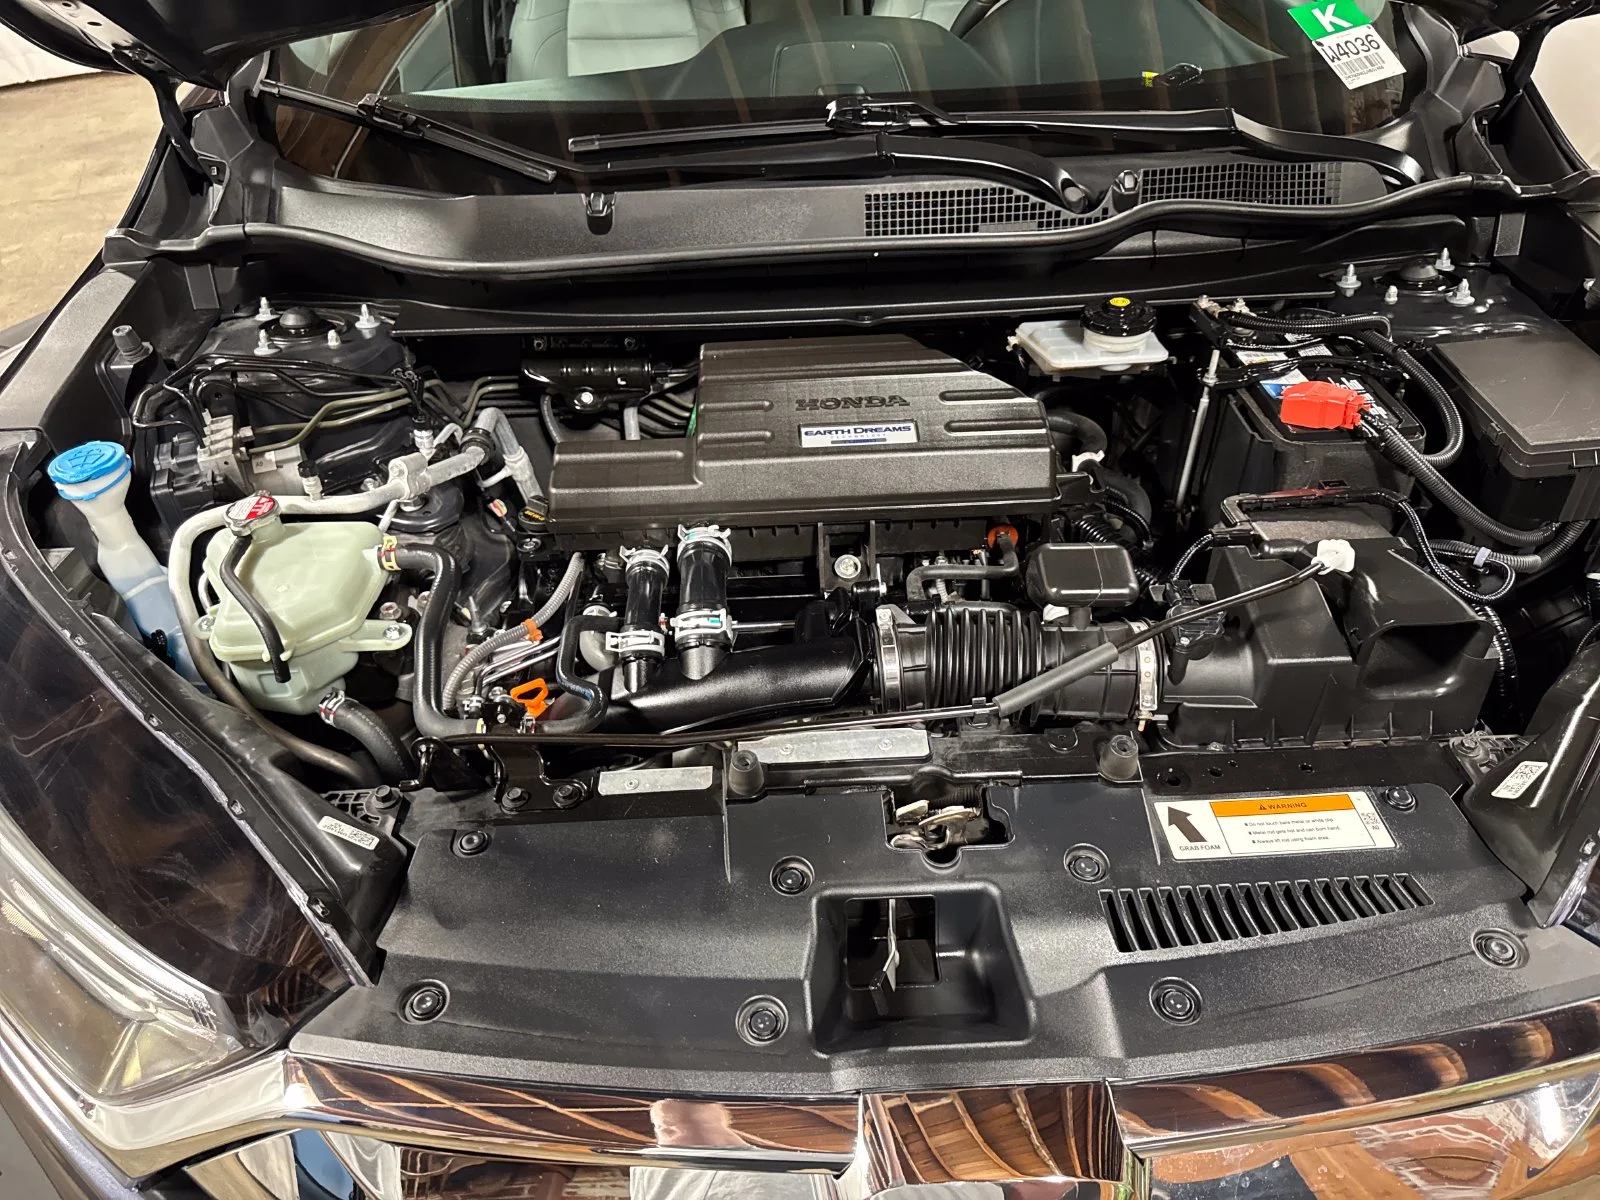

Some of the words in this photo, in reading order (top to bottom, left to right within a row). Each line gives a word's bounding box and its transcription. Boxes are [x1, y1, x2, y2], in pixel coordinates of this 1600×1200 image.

[1311, 3, 1353, 33] K
[1321, 34, 1380, 63] W4036
[795, 395, 910, 411] HONDA
[804, 428, 850, 436] EARTH
[1268, 802, 1307, 810] WARNING
